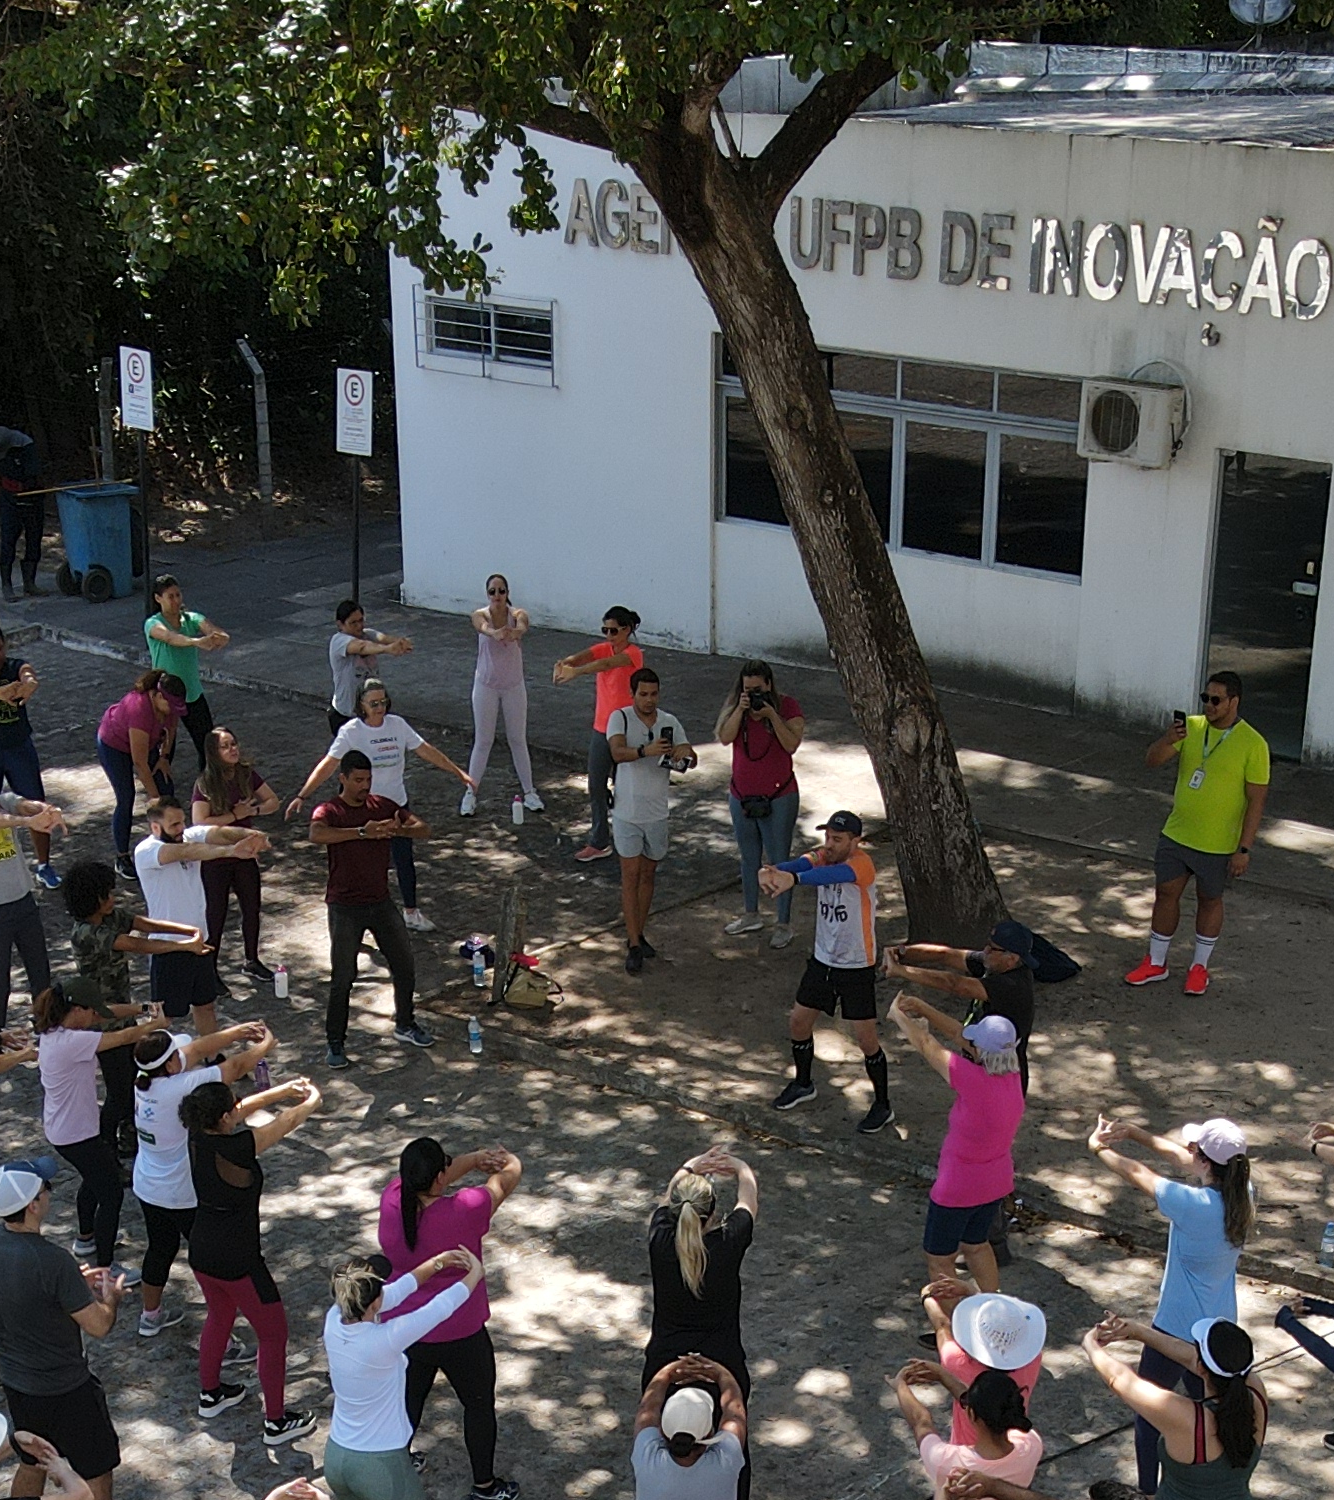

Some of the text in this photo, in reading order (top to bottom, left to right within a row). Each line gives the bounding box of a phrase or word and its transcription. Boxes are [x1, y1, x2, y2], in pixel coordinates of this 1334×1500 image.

[790, 195, 923, 281] UFPB
[938, 209, 1015, 292] DE
[1028, 215, 1333, 347] INOVAÇÃO
[351, 381, 359, 398] E
